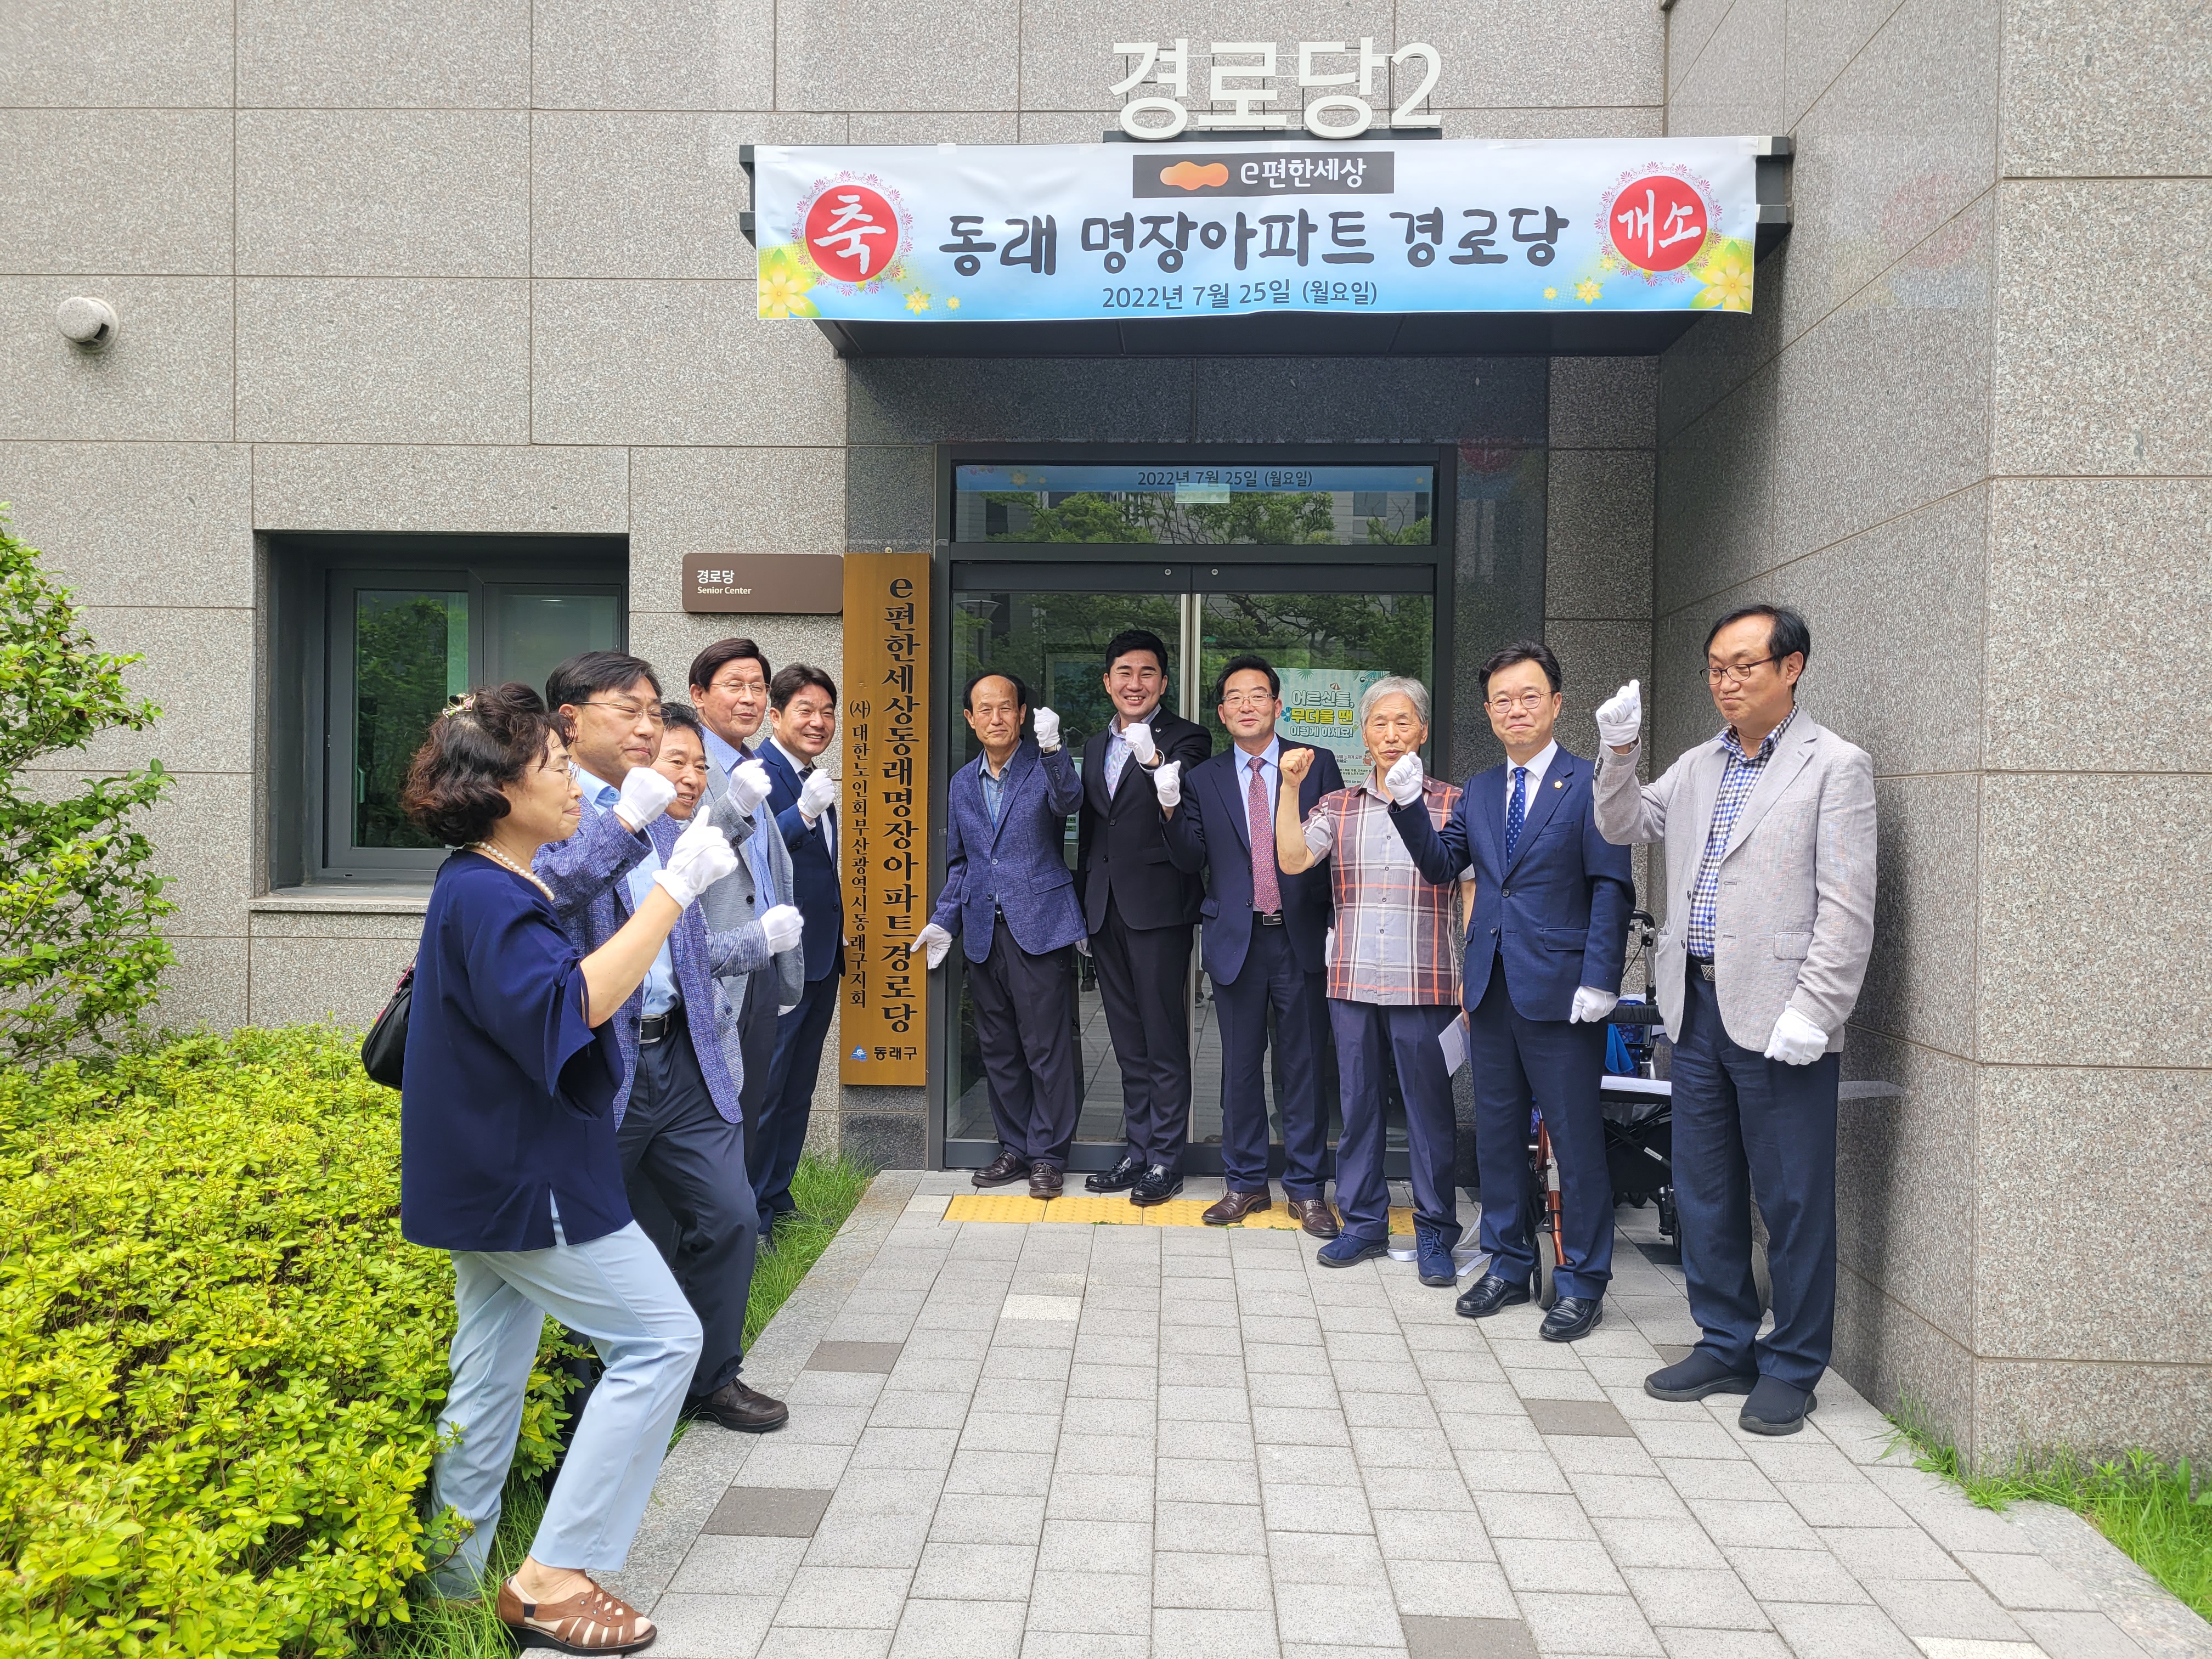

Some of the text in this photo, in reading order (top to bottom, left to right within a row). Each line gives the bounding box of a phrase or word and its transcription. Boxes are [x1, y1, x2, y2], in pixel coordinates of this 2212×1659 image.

[1108, 37, 1442, 140] 경로당2
[1240, 157, 1367, 188] e편한세상
[813, 194, 887, 275] 축
[1617, 189, 1701, 258] 개소
[939, 205, 1570, 276] 동래 명장아파트 경로당
[1102, 279, 1378, 310] 2022년 7월 25일 (월요일)
[1137, 470, 1313, 487] 2022년 7월 25일 (월요일)
[697, 569, 735, 584] 경로당
[697, 586, 752, 595] Senior Center
[1291, 690, 1355, 709] 어르신들,
[1290, 708, 1354, 725] 무더울 땐
[1290, 725, 1354, 738] 이렇게 하세요!
[881, 578, 921, 1033] e편한세상동래명장아파트경로당
[873, 1046, 918, 1061] 동래구
